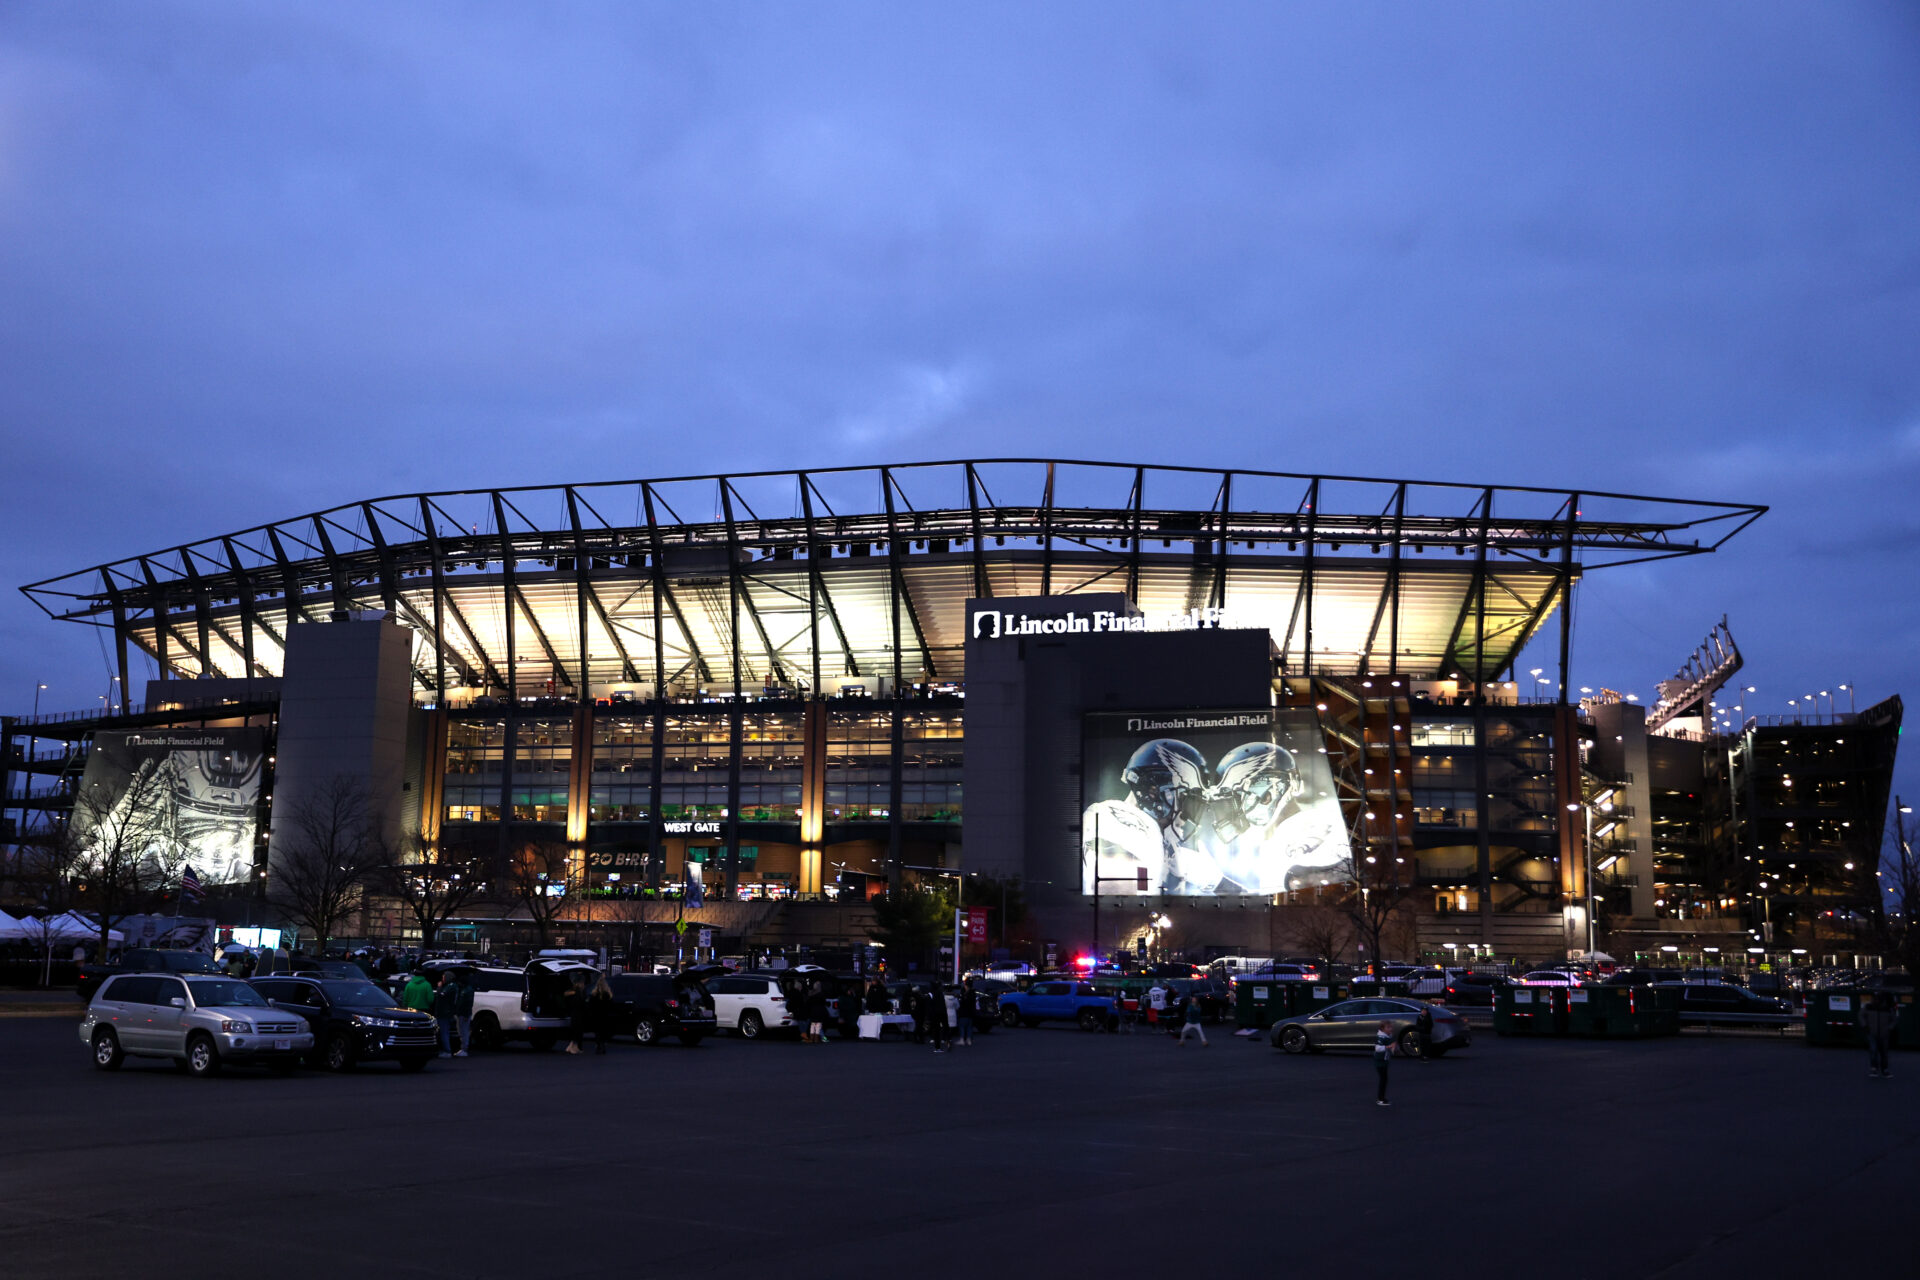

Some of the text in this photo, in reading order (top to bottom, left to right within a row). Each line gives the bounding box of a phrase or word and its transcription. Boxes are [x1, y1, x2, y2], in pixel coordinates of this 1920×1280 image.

[1004, 611, 1089, 635] Lincoln
[1093, 608, 1199, 632] Finaial
[1143, 714, 1268, 730] Lincoln Financial Field
[137, 736, 225, 746] Lincoln Financial Field
[663, 822, 721, 833] WEST GATE
[589, 851, 613, 866] GO
